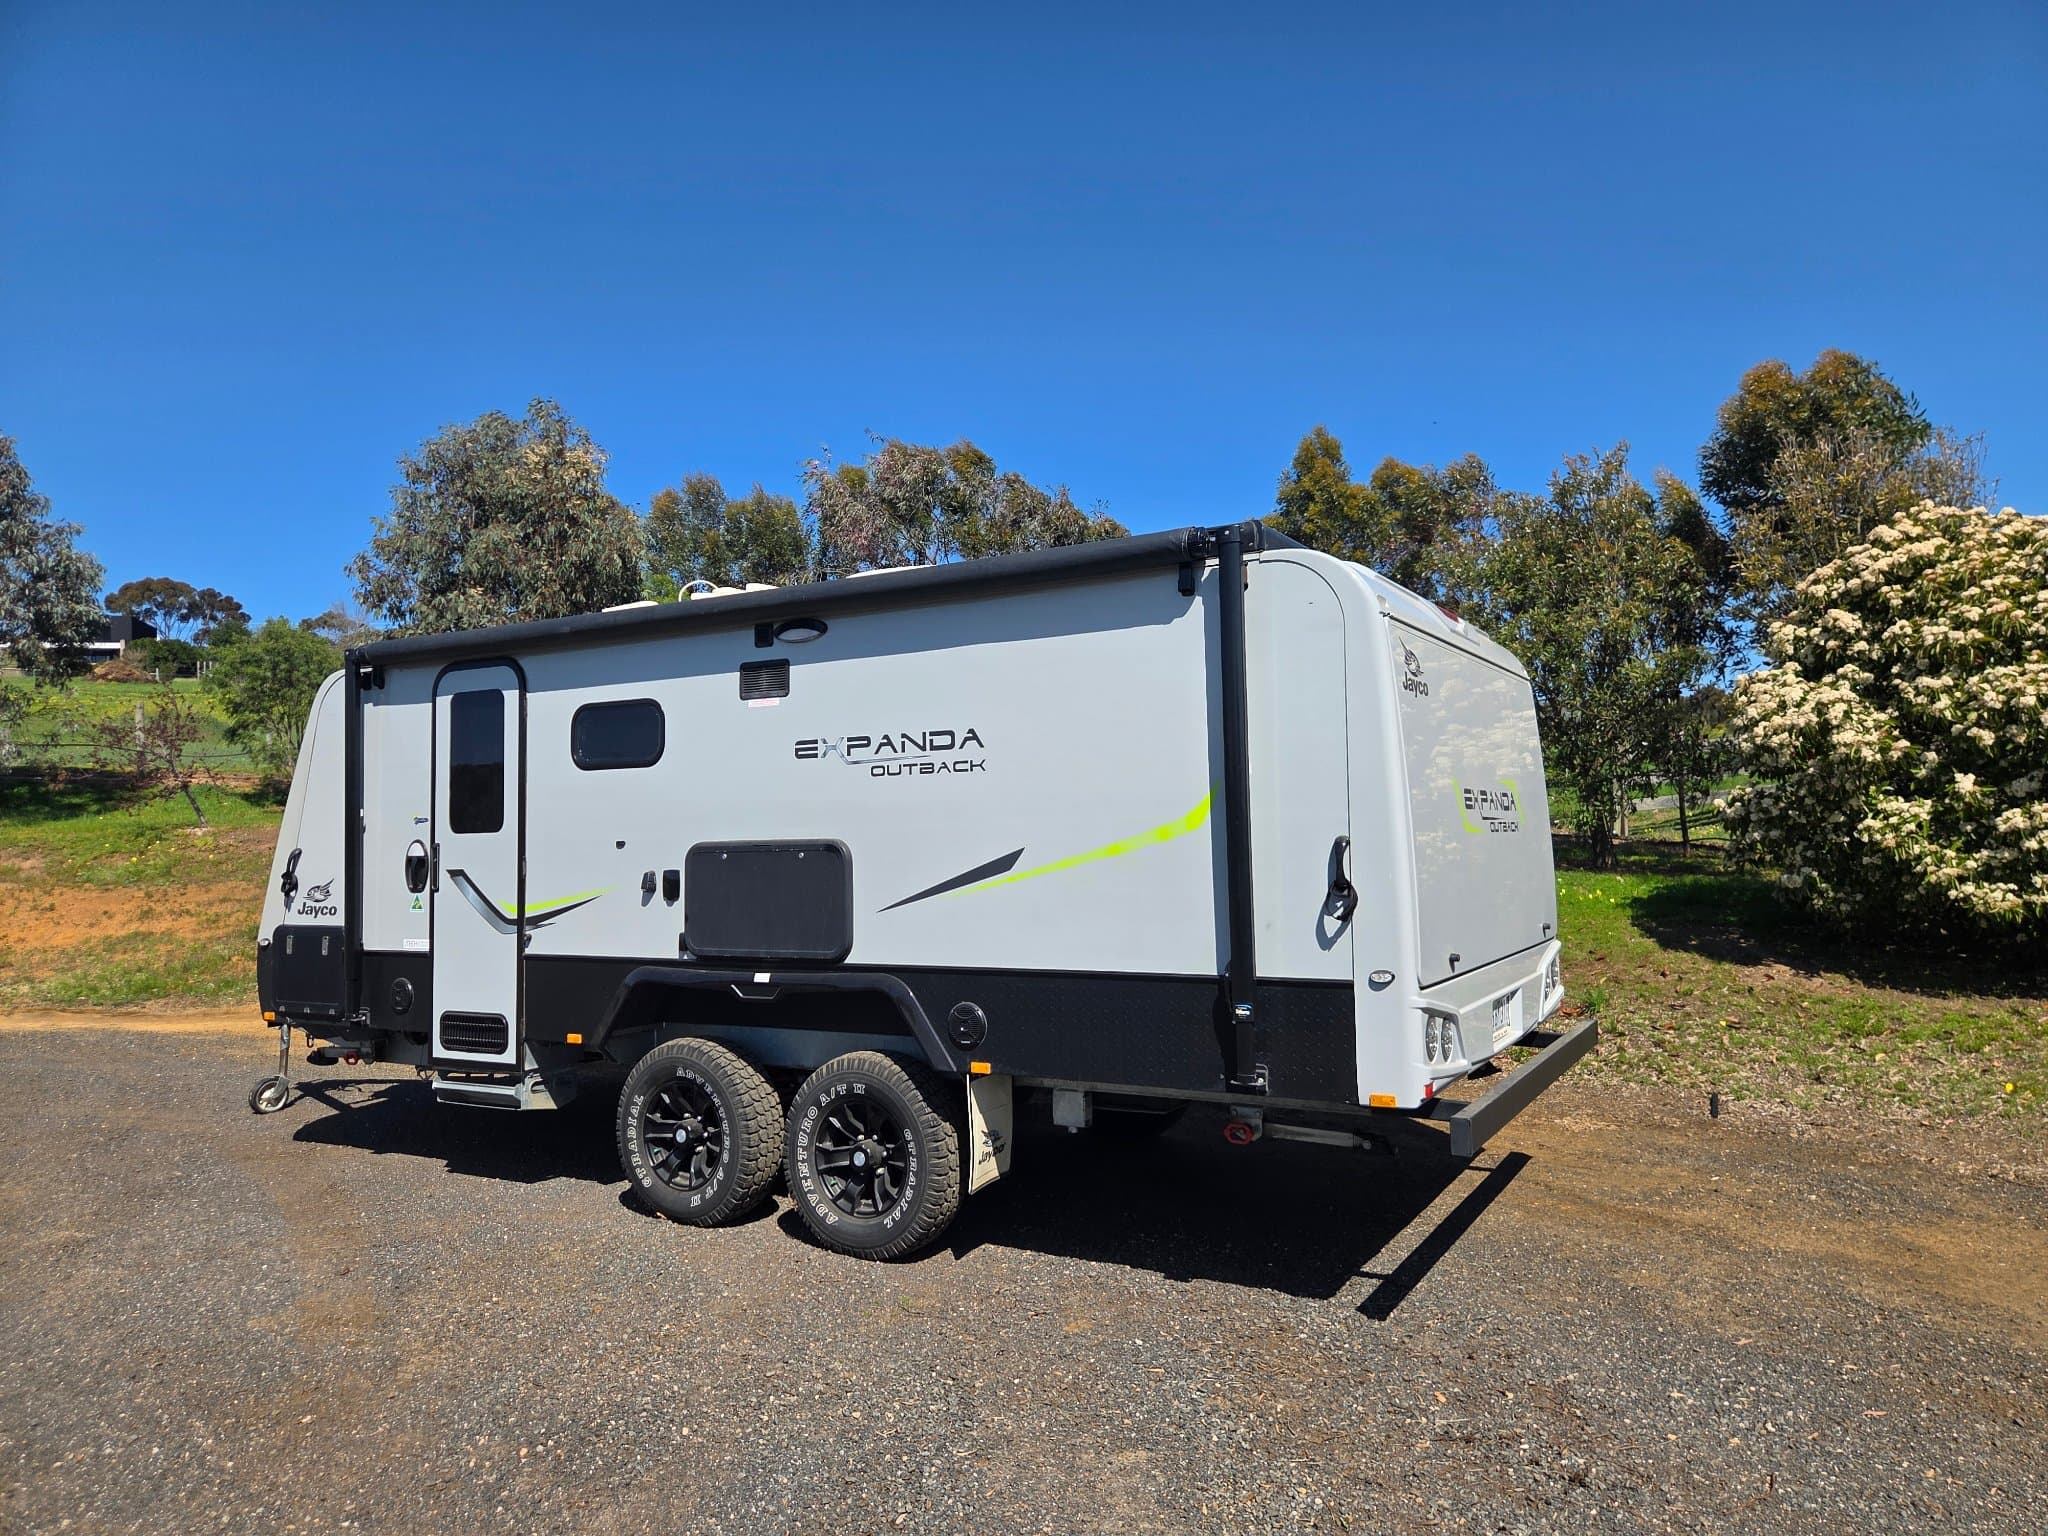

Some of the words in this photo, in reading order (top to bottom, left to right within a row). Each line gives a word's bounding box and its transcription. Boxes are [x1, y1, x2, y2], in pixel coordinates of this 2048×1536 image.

[1402, 671, 1429, 698] Jayco
[794, 727, 985, 762] EXPANDA
[870, 758, 986, 777] OUTBACK
[1463, 787, 1517, 813] EXPANDA
[1489, 821, 1520, 833] OUTBACK
[297, 901, 338, 919] Jayco
[676, 1066, 731, 1164] ADVENTURO
[705, 1166, 724, 1200] A/T
[797, 1106, 839, 1225] ADVENTURO
[819, 1083, 847, 1106] A/T
[978, 1141, 1006, 1165] Jayco
